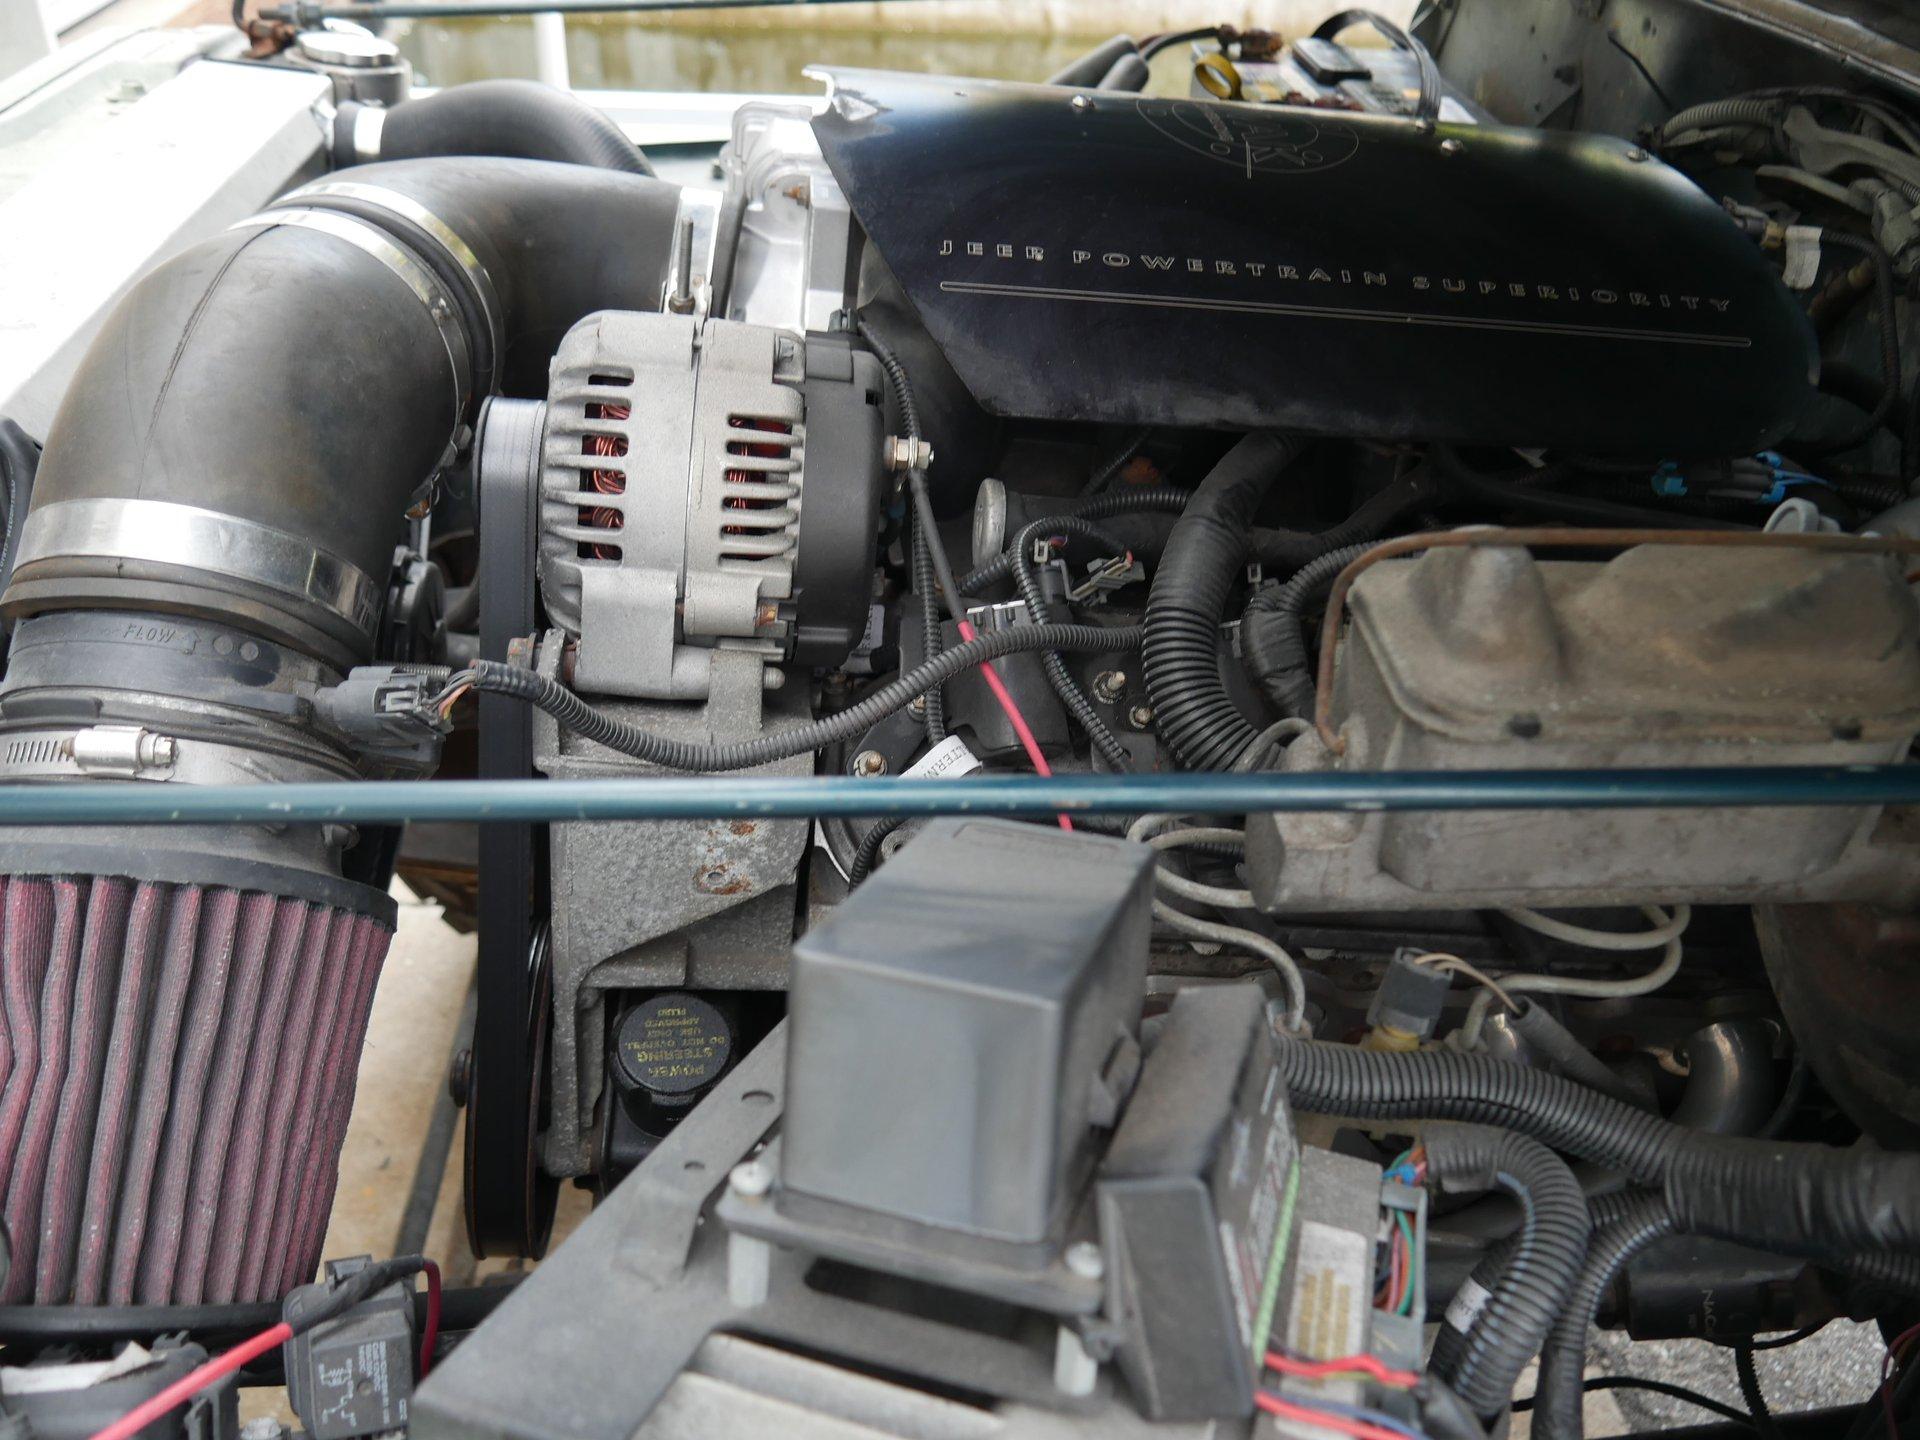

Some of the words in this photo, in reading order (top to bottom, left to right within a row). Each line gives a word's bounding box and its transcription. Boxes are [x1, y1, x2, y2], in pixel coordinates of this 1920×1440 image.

[1072, 249, 1387, 287] POWERTRAIN
[1412, 275, 1731, 313] SUPERIORITY
[123, 623, 176, 643] FLOW
[636, 1047, 713, 1063] STEERING
[648, 1063, 705, 1078] POWER
